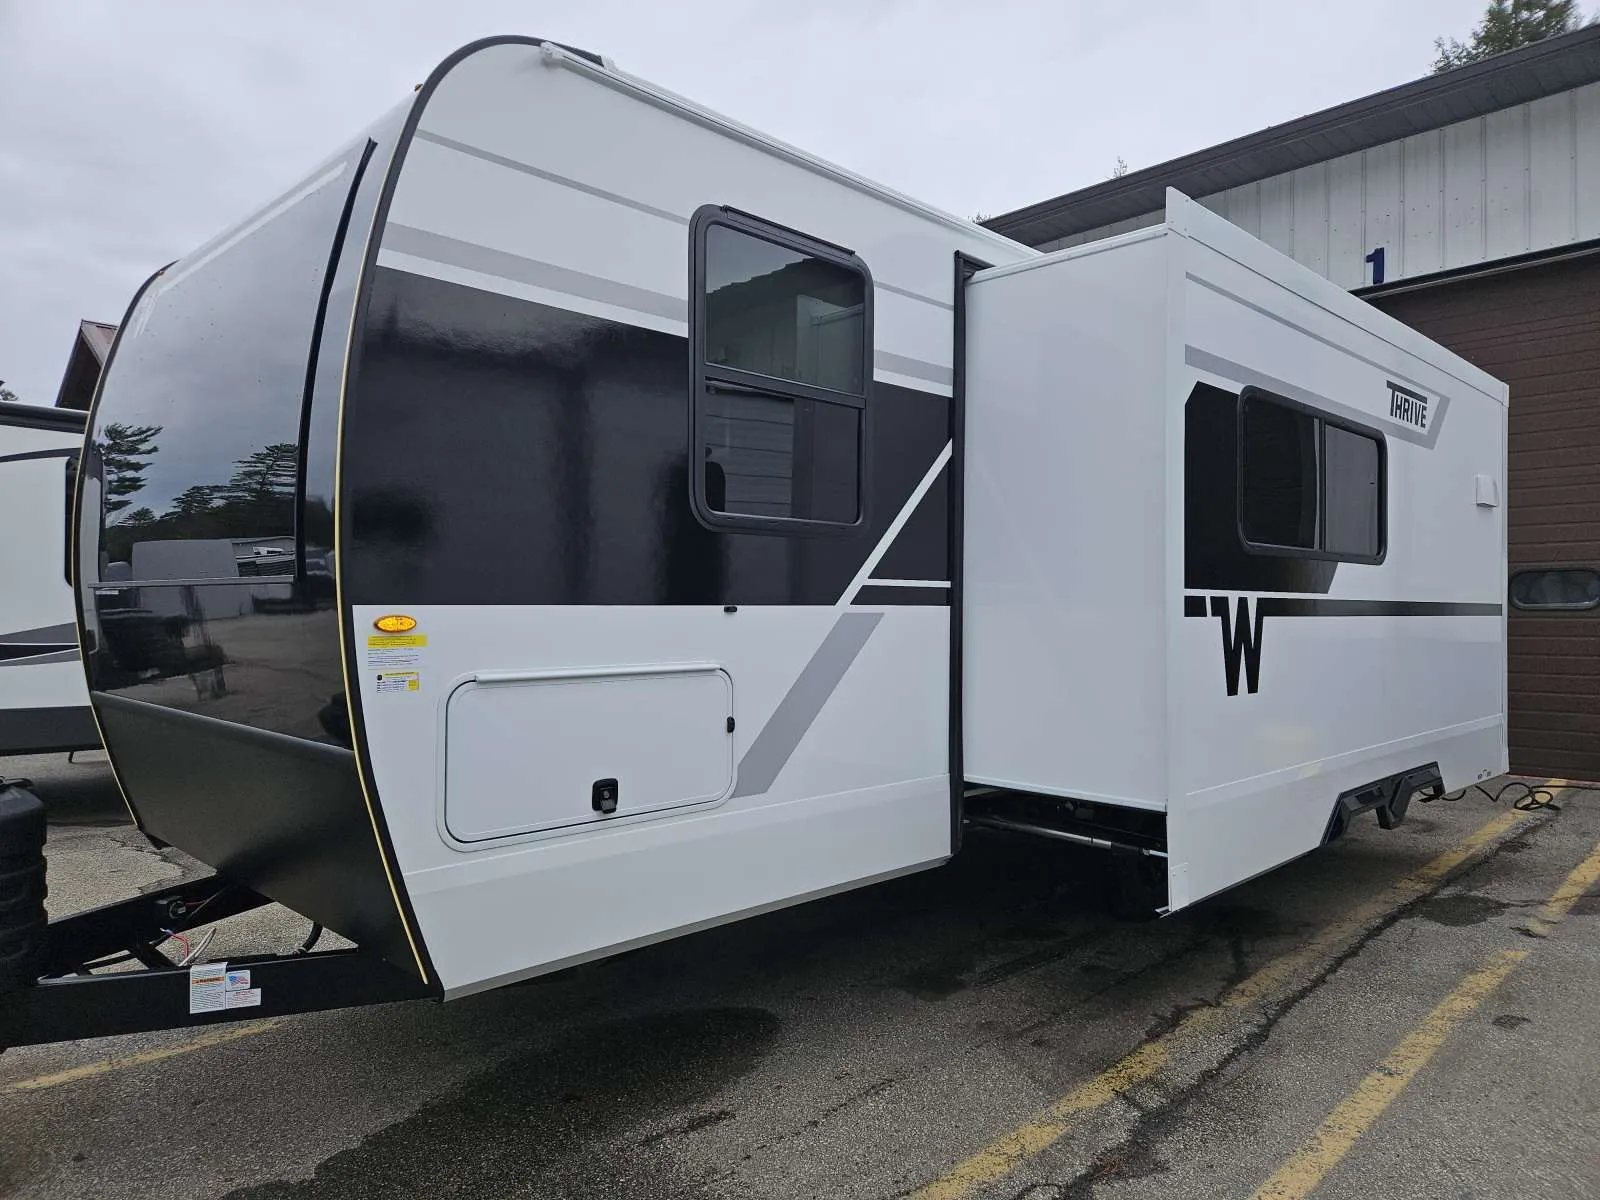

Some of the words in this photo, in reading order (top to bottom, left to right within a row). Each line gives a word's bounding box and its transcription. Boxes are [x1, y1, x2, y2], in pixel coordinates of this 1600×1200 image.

[1366, 247, 1384, 285] 1
[1386, 380, 1427, 428] THRIVE
[1210, 596, 1264, 696] W
